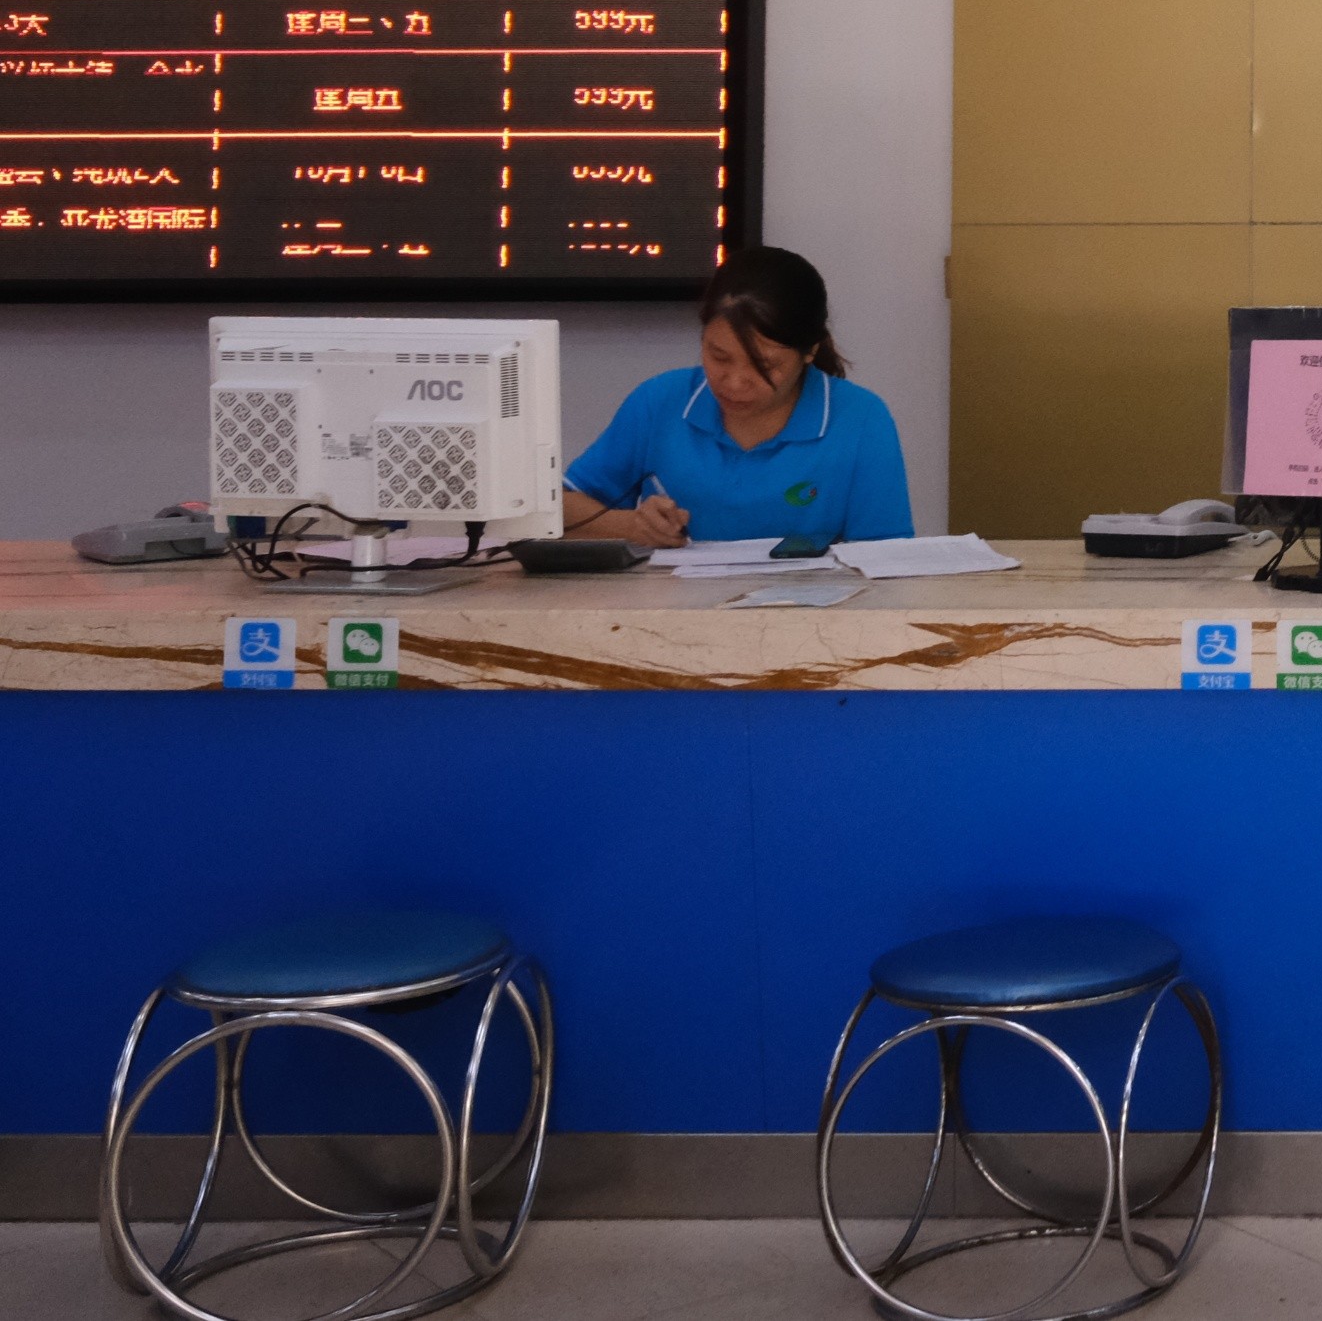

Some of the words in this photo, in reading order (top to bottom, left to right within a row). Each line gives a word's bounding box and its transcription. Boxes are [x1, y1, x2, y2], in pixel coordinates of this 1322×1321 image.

[407, 380, 464, 402] AOC
[1198, 674, 1236, 689] 支付宝
